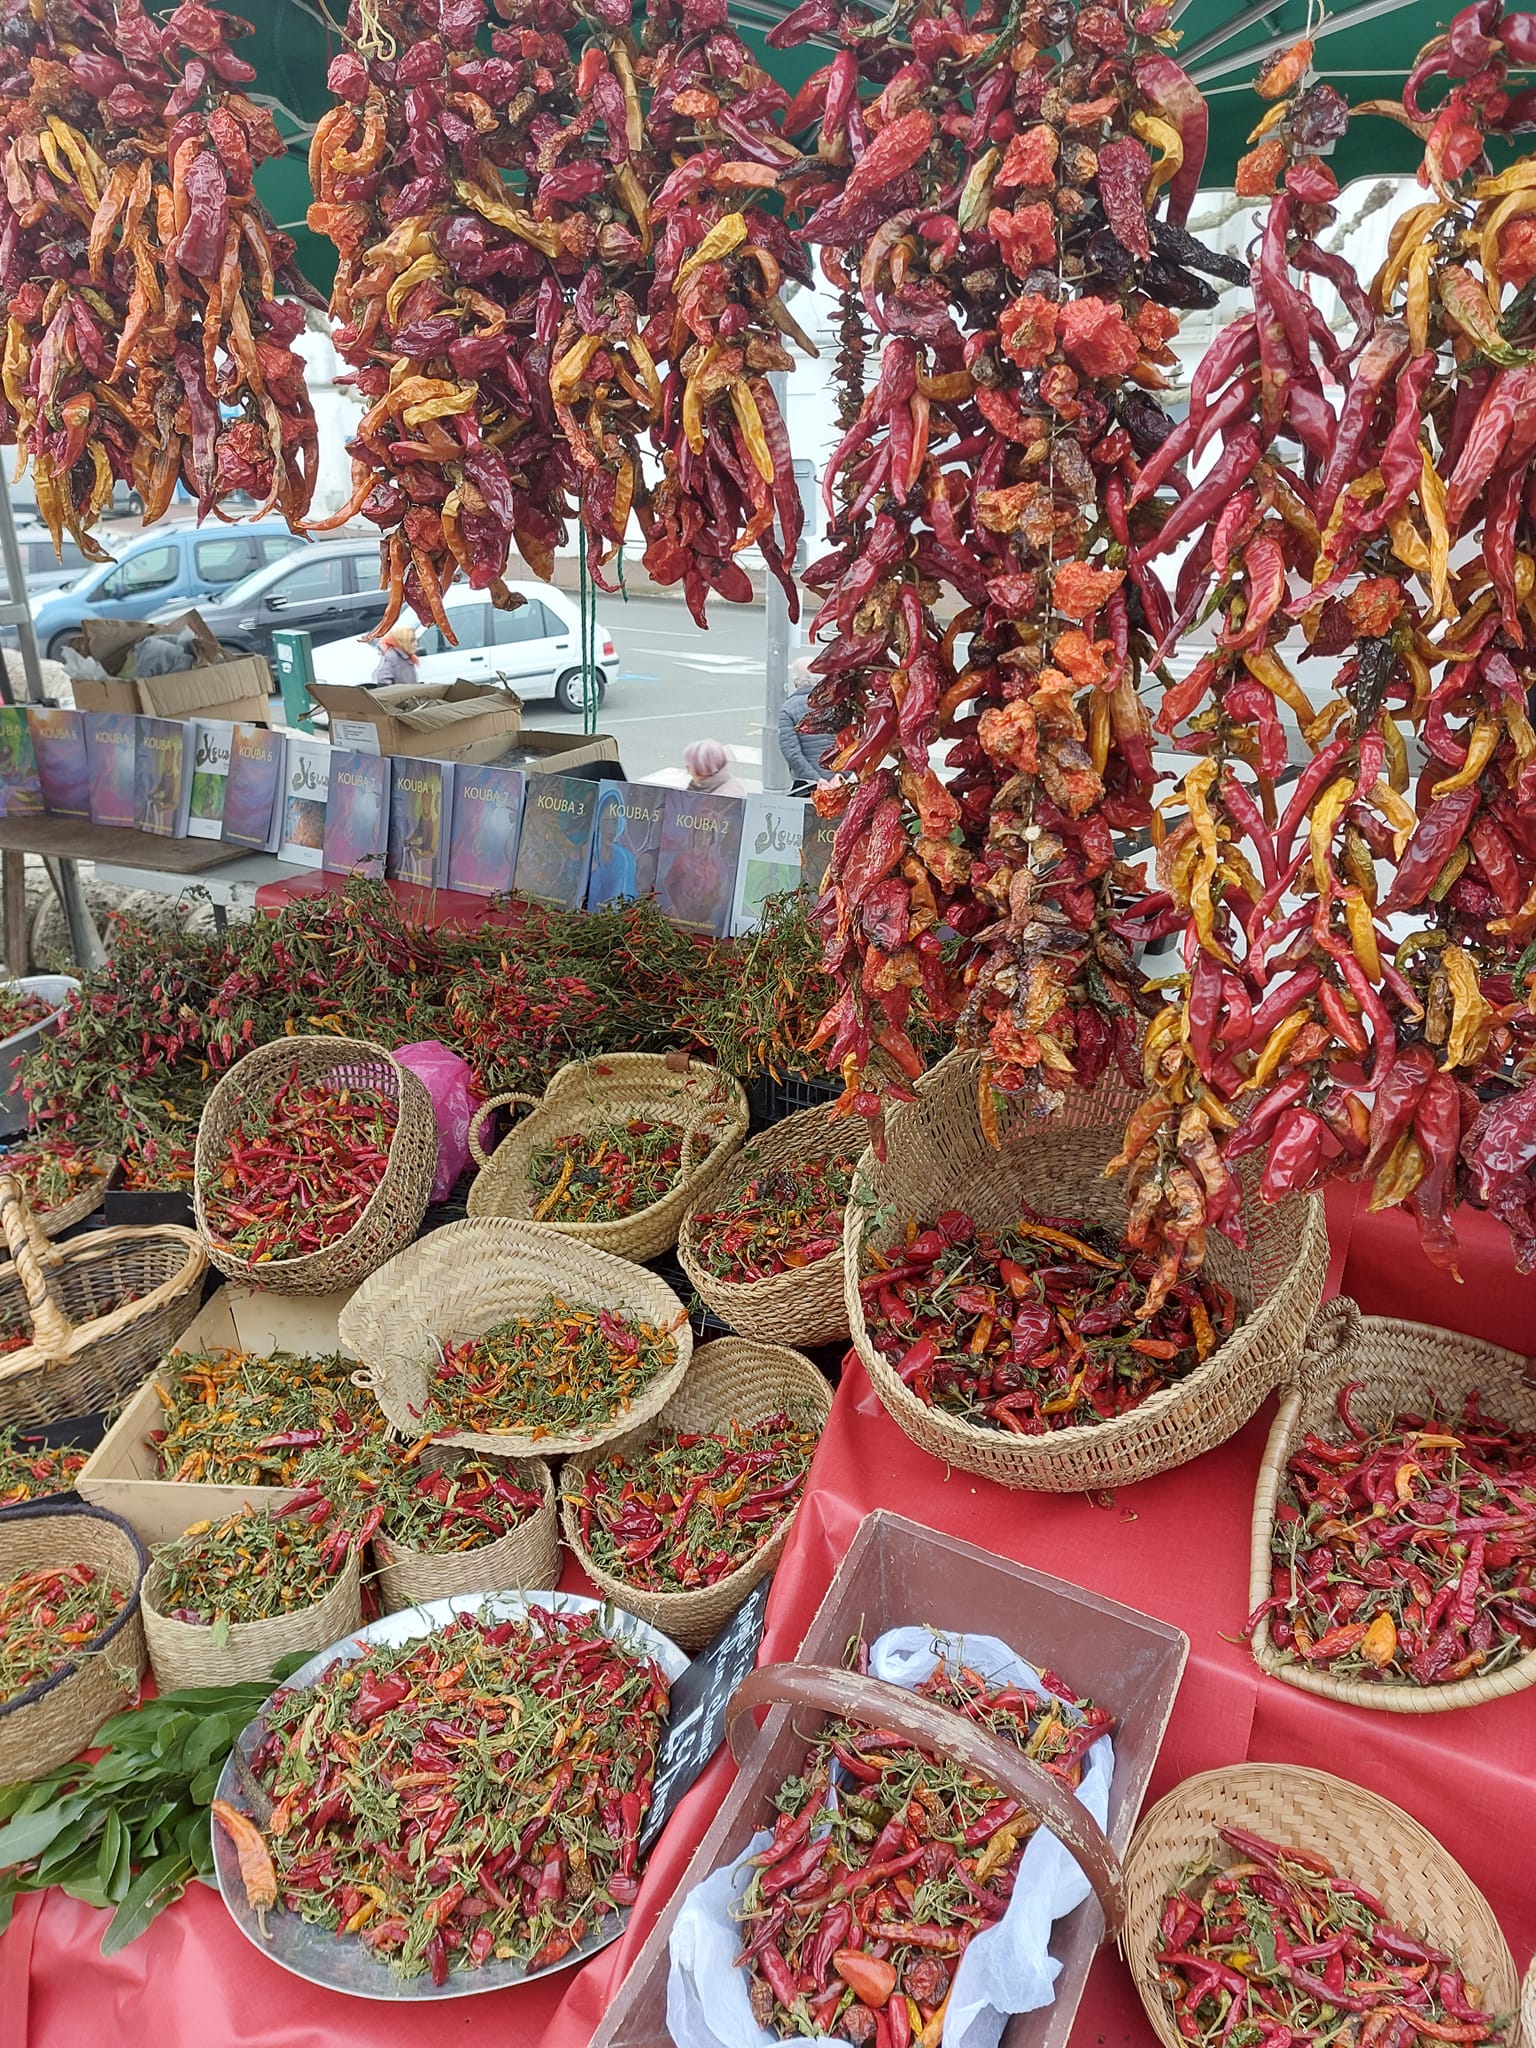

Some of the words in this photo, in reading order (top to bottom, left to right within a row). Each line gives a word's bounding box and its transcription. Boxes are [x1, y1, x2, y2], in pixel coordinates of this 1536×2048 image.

[39, 727, 71, 740] KOUBA
[94, 731, 129, 745] KOUBA
[143, 735, 172, 753] KOUBA
[239, 745, 267, 762] KOUBA
[267, 751, 273, 762] 6
[337, 771, 369, 788] KOUBA
[370, 777, 377, 790] 7
[397, 777, 429, 794] KOUBA
[430, 783, 435, 795] 1
[463, 786, 501, 802] KOUBA
[502, 791, 510, 804] 7
[537, 795, 575, 814] KOUBA
[576, 802, 585, 815] 3
[609, 803, 650, 821] KOUBA
[651, 809, 660, 823] 5
[676, 813, 719, 833] KOUBA
[720, 820, 729, 834] 2
